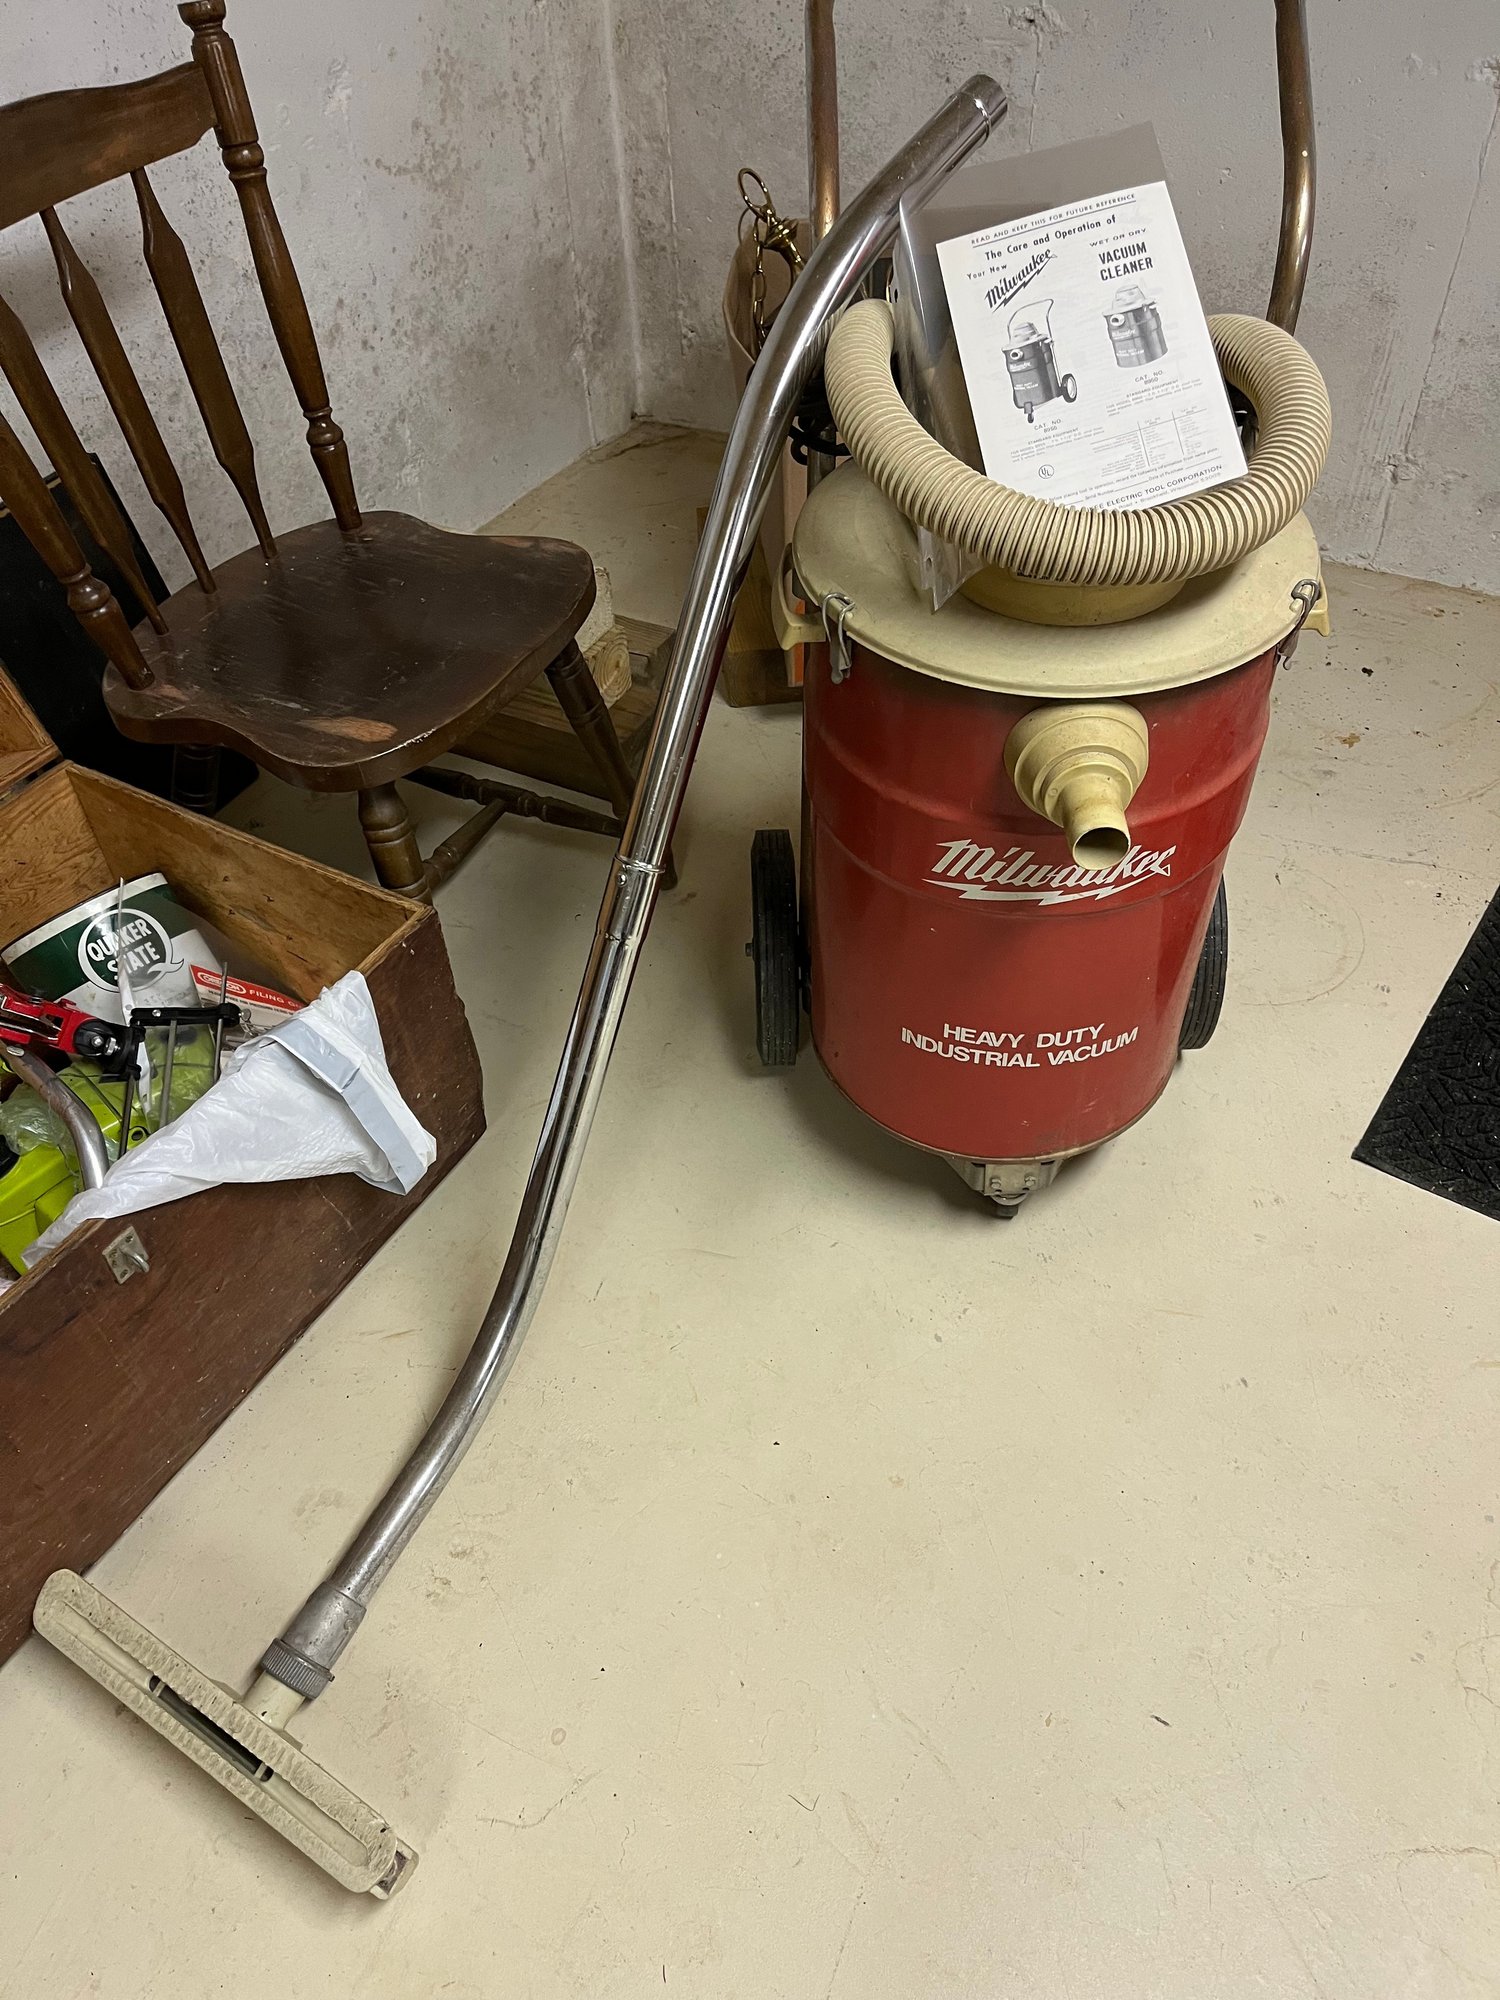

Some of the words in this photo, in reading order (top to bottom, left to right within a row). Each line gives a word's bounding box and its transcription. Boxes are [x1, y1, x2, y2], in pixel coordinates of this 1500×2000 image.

[971, 235, 991, 245] READ
[993, 229, 1009, 241] AND
[1011, 223, 1029, 235] KEEP
[1030, 217, 1046, 229] THIS
[1049, 212, 1063, 224] FOR
[1065, 204, 1093, 218] FUTURE
[1095, 193, 1136, 209] REFERENCE
[984, 250, 1002, 261] The
[1006, 242, 1028, 254] Care
[1032, 233, 1050, 246] and
[1054, 220, 1101, 240] Operation
[1106, 213, 1117, 225] of
[1089, 239, 1108, 249] WET
[1112, 233, 1125, 242] OR
[1128, 227, 1147, 238] DRY
[1098, 241, 1147, 265] VACUUM
[966, 270, 985, 281] Your
[989, 263, 1008, 274] New
[984, 248, 1052, 309] Milwaukee
[1100, 256, 1154, 282] CLEANER
[1106, 491, 1143, 507] ELECTRIC
[1145, 484, 1165, 495] TOOL
[1166, 464, 1222, 488] CORPORATION
[931, 839, 1176, 888] Milwaukee
[87, 918, 152, 962] QUAKER
[106, 941, 161, 974] STATE
[249, 989, 285, 1004] FILING
[901, 1027, 1041, 1067] INDUSTRIAL
[1047, 1026, 1139, 1066] VACUUM
[943, 1023, 1025, 1048] HEAVY
[1036, 1023, 1105, 1048] DUTY
